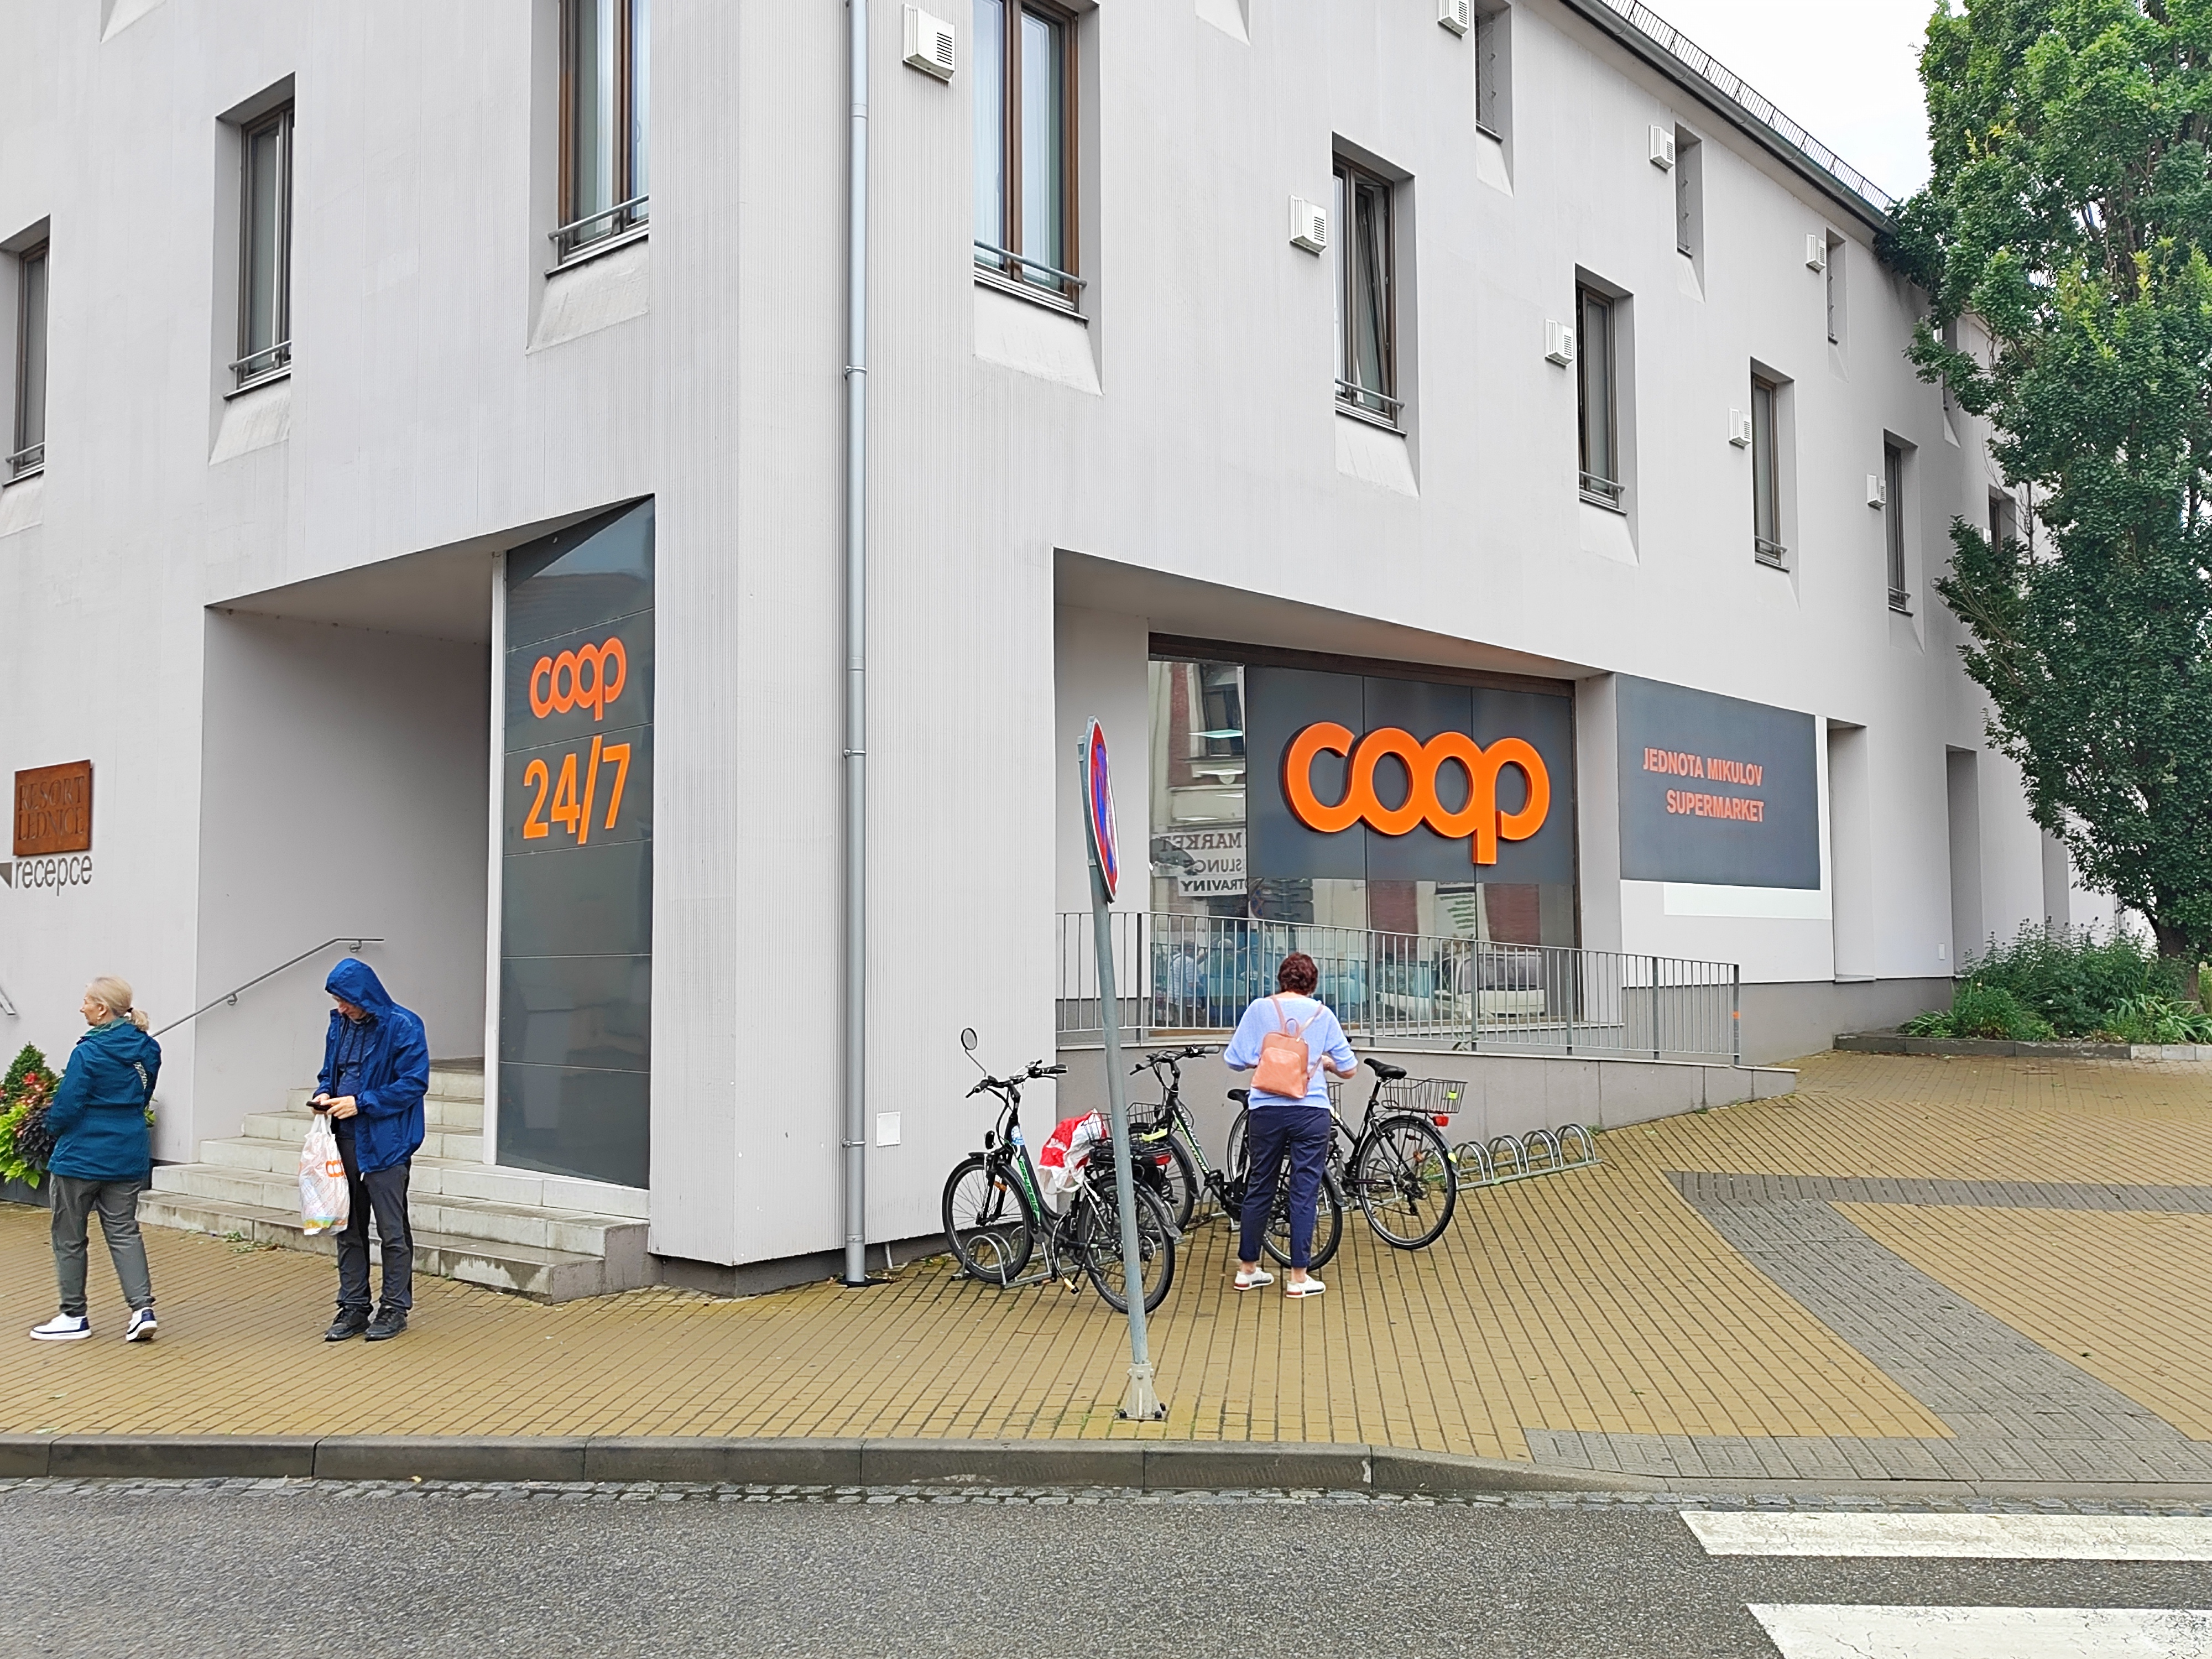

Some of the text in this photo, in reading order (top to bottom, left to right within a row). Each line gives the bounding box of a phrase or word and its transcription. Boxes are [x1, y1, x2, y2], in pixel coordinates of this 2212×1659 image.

[529, 636, 627, 721] coop
[1642, 747, 1763, 787] JEDNOTA MIKULOV
[18, 775, 85, 812] RESORT
[524, 735, 630, 845] 24/7
[1282, 722, 1551, 865] coop
[1666, 789, 1765, 822] SUPERMARKET
[18, 807, 84, 841] LEDNICE
[15, 855, 93, 896] recepce
